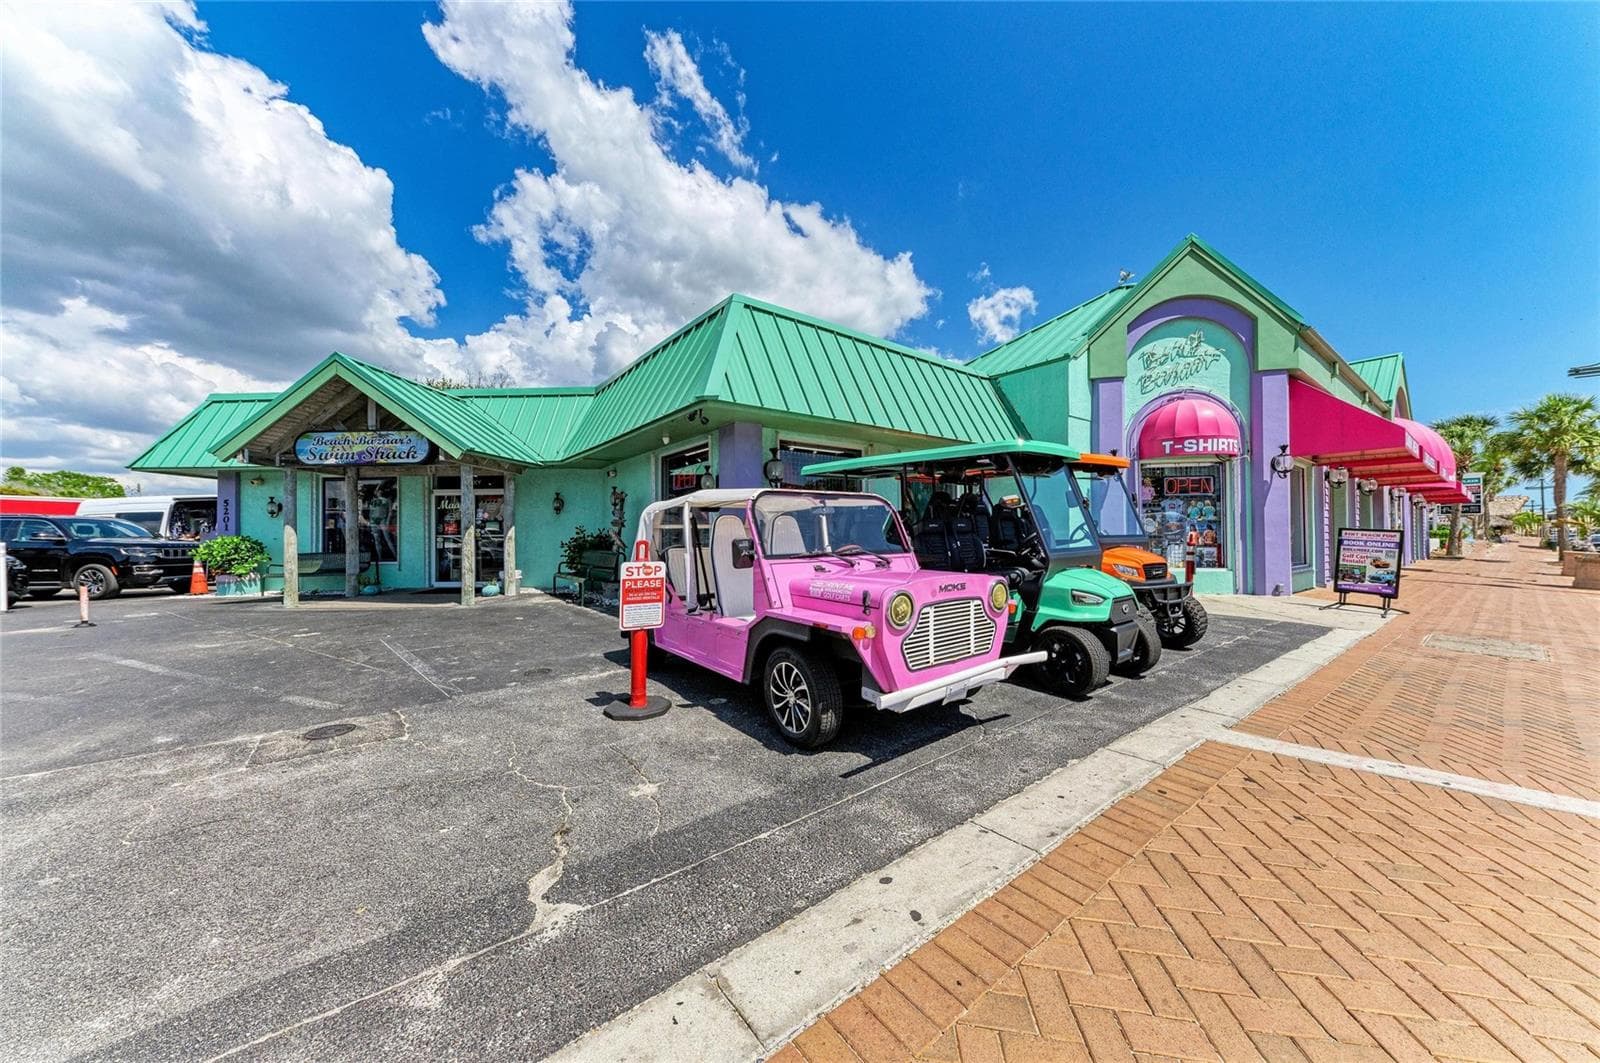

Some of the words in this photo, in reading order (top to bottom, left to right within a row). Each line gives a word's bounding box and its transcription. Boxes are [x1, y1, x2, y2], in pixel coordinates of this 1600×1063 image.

[312, 435, 351, 446] Beach
[353, 435, 412, 446] Bazaar's
[1162, 438, 1238, 454] T-SHIRTS
[307, 446, 356, 461] Swim
[362, 445, 418, 461] Shack
[1166, 478, 1213, 494] OPEN
[222, 499, 230, 531] 5201
[625, 565, 662, 576] STOP
[625, 580, 662, 588] PLEASE
[939, 583, 966, 593] MOKE
